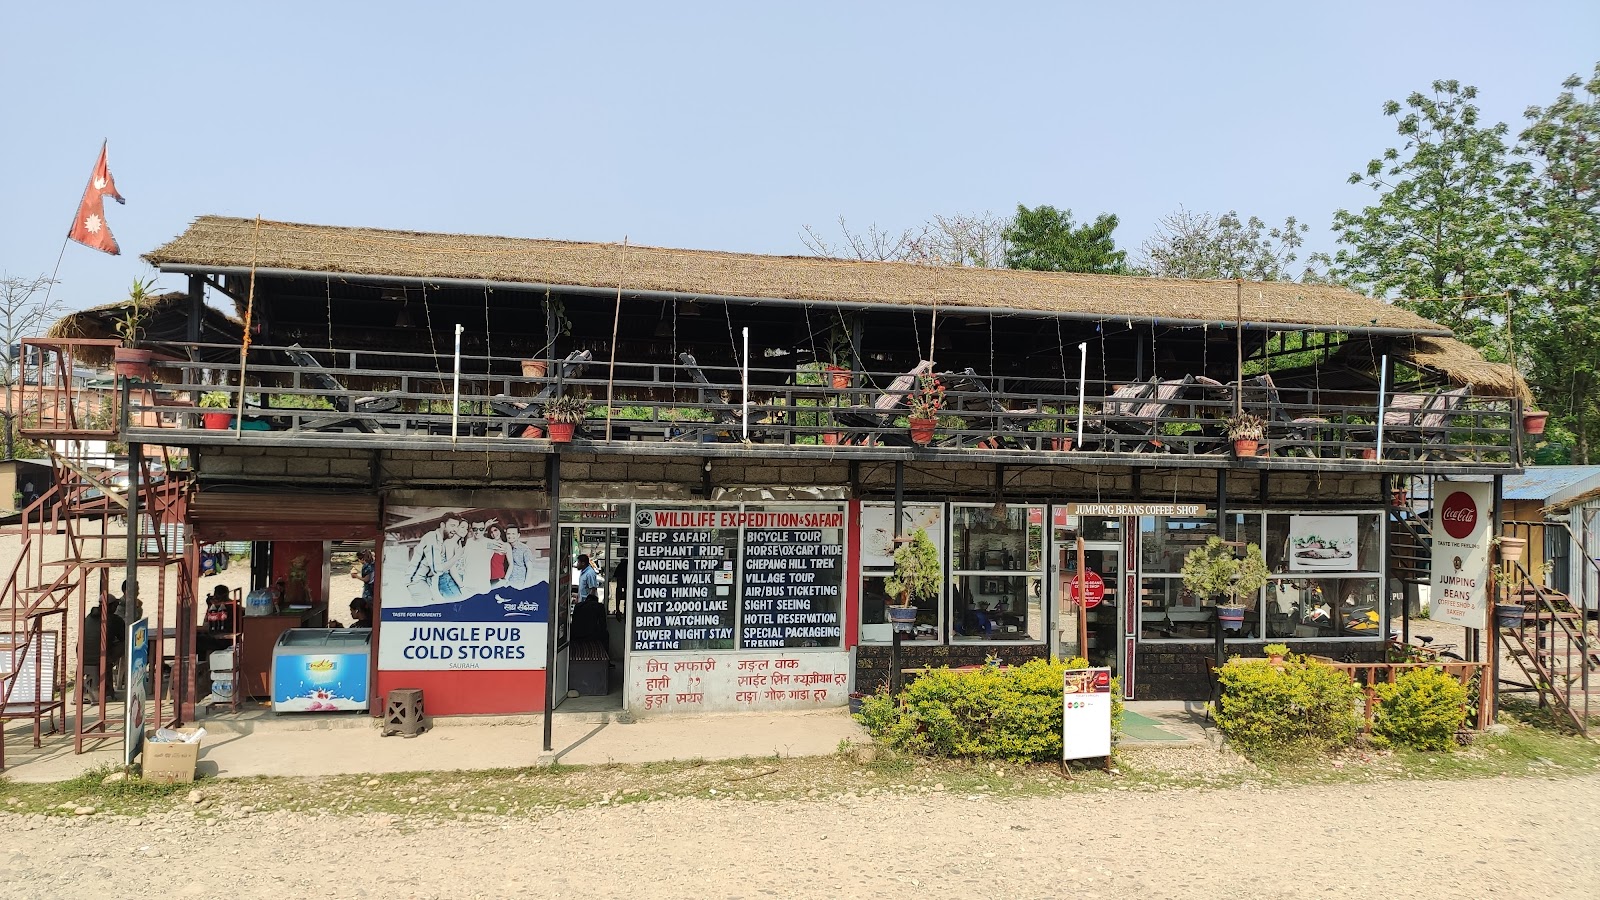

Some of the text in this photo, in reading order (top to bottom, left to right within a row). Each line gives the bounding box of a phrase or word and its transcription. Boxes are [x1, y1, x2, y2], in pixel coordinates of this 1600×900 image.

[1075, 504, 1114, 515] JUMPING
[1116, 504, 1144, 515] BEANS
[1145, 504, 1174, 515] COFFEE
[1176, 504, 1199, 515] SHOP
[654, 511, 716, 527] WILDLIFE
[720, 512, 799, 528] EXPEDITION
[804, 513, 843, 527] SAFARI
[638, 532, 711, 543] JEEP SAFARI
[747, 531, 822, 542] BICYCLE TOUR
[637, 545, 725, 557] ELEPHANT RIDE
[821, 544, 843, 556] RIDE
[637, 559, 719, 571] CANOEING TRIP
[745, 558, 835, 570] CHEPANG HILL TREK
[637, 573, 712, 585] JUNGLE WALK
[745, 572, 816, 584] VILLAGE TOUR
[1439, 575, 1476, 588] JUMPING
[636, 587, 709, 599] LONG HIKING
[744, 585, 838, 597] AIR/BUS TICKETING
[1444, 588, 1470, 601] BEANS
[636, 600, 728, 614] VISIT 20,000 LAKE
[744, 599, 811, 611] SIGHT SEEING
[1437, 599, 1456, 607] COFFEE
[1456, 601, 1470, 609] SHOP
[635, 615, 720, 628] BIRD WATCHING
[743, 613, 837, 625] HOTEL RESERVATION
[409, 627, 521, 642] JUNGLE PUB
[635, 628, 733, 641] TOWER NIGHT STAY
[743, 627, 841, 639] SPECIAL PACKAGEING
[635, 641, 680, 650] RAFTING
[743, 640, 785, 648] TREKING
[403, 645, 526, 660] COLD STORES
